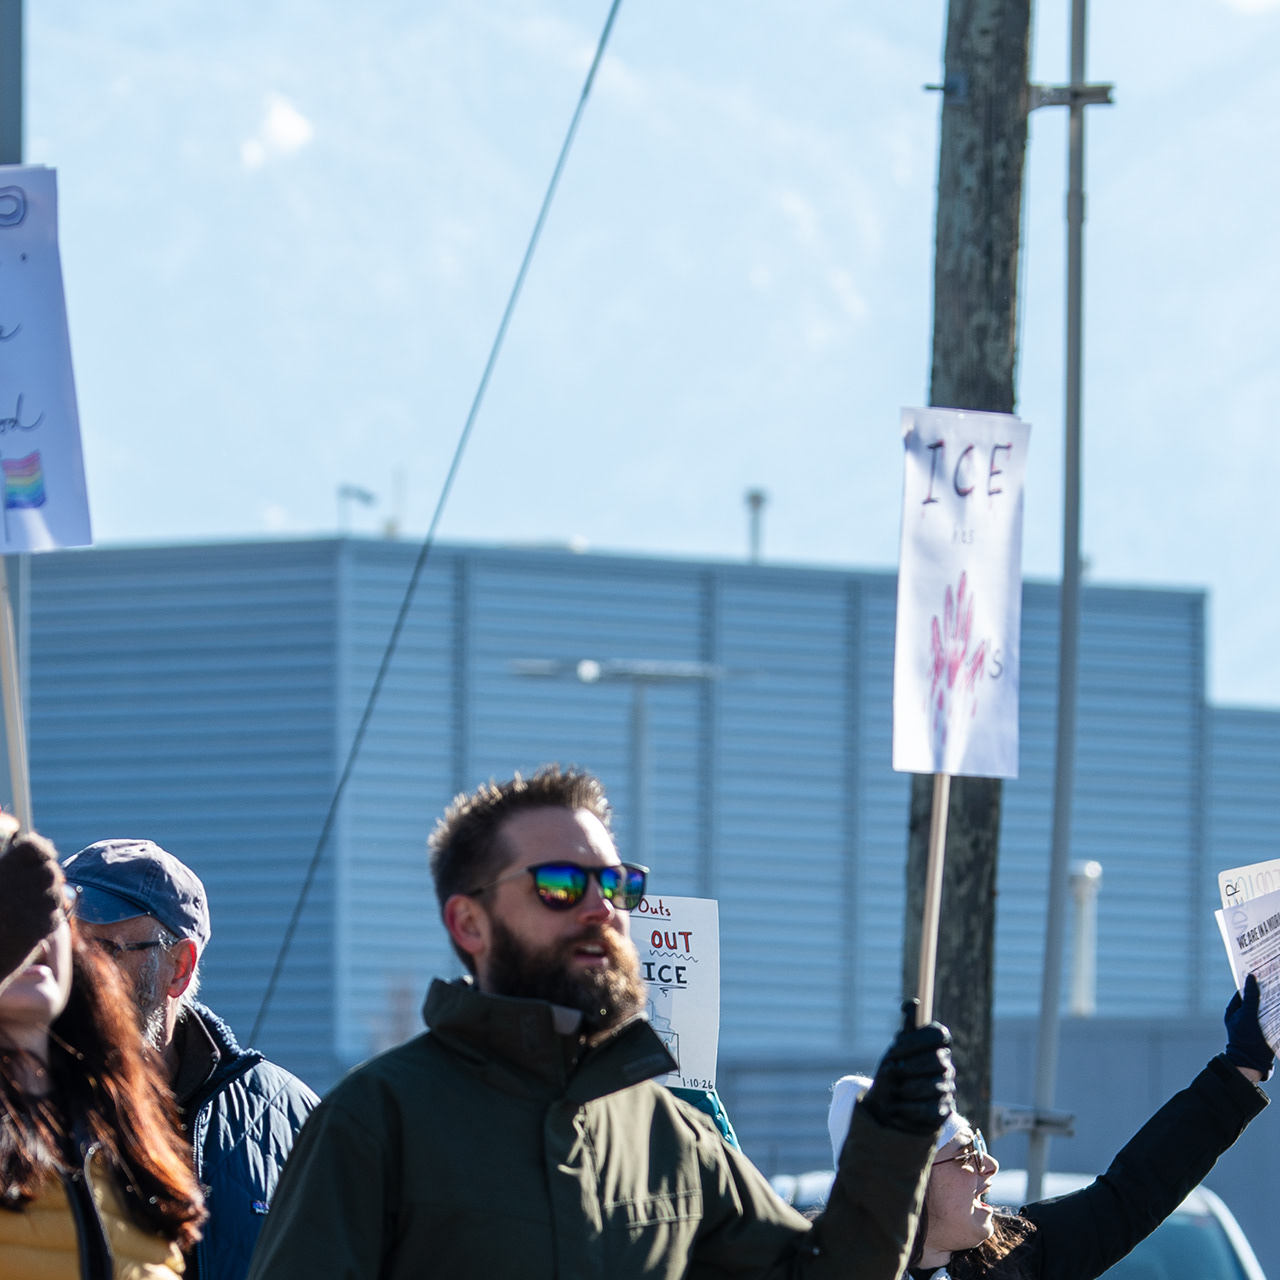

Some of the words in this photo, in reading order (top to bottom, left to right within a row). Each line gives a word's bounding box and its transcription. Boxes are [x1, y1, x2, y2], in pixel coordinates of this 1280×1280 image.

[922, 438, 1013, 505] ICE
[638, 898, 671, 916] Outs
[651, 930, 693, 953] OUT
